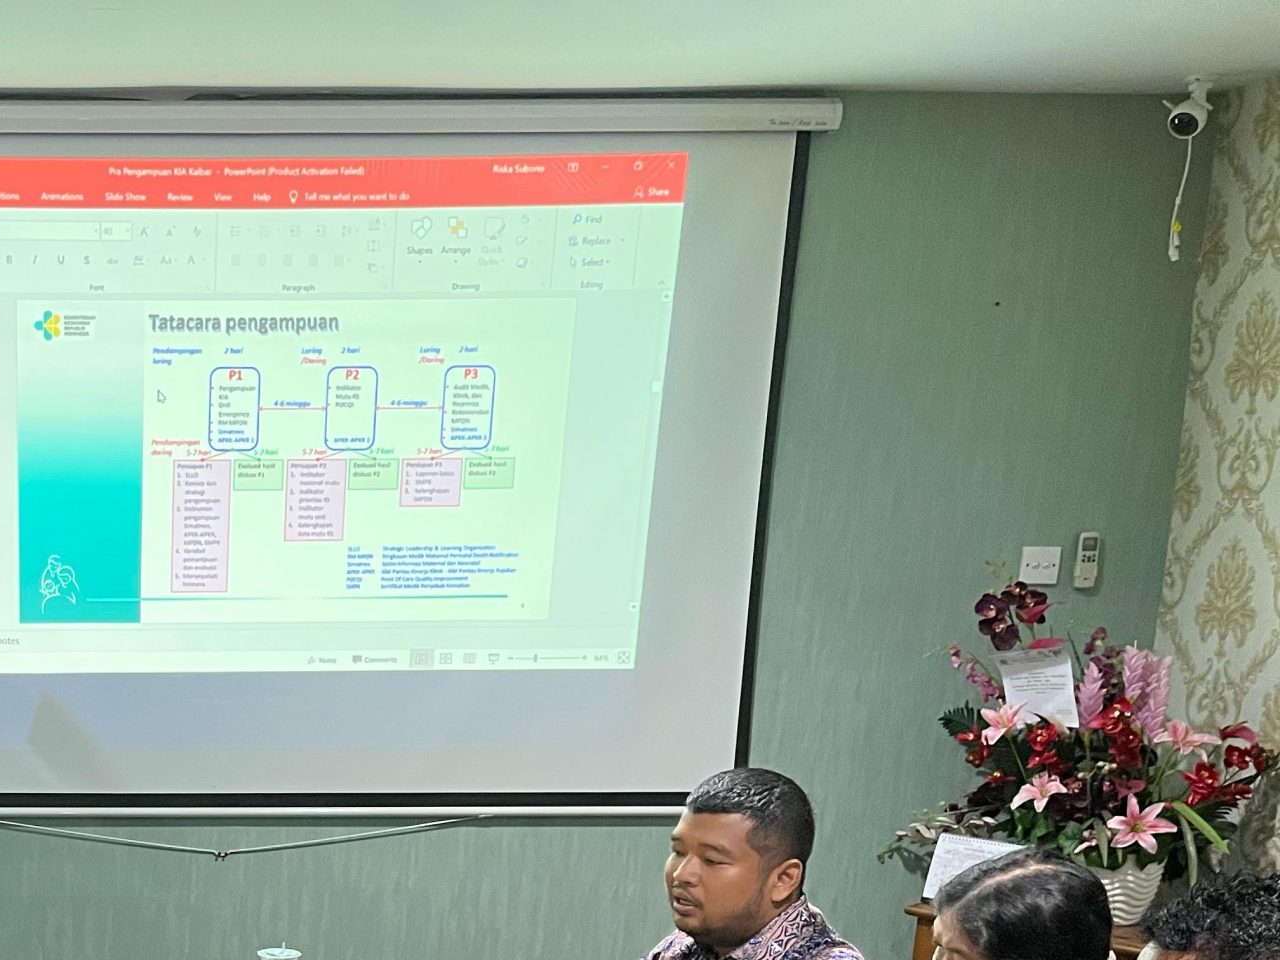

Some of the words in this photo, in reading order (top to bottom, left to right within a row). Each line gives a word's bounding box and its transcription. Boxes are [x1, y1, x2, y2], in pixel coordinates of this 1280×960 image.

[109, 167, 121, 176] Pra
[123, 167, 172, 178] Pengampuan
[173, 167, 187, 176] KIA
[224, 167, 266, 176] PowerPoint
[268, 167, 300, 177] (Product
[301, 167, 338, 176] Activation
[340, 166, 365, 177] Failed)
[493, 164, 513, 173] Riska
[41, 192, 84, 201] Animations
[104, 192, 123, 201] Slide
[125, 192, 146, 201] Show
[167, 192, 193, 201] Review
[214, 192, 232, 201] View
[648, 188, 669, 196] Share
[253, 192, 271, 203] Help
[304, 192, 318, 201] Tell
[332, 192, 351, 201] what
[352, 194, 366, 203] you
[368, 193, 386, 201] want
[398, 192, 410, 201] do
[585, 215, 602, 224] Find
[582, 236, 611, 247] Replace
[407, 246, 433, 256] Shapes
[441, 246, 471, 255] Arrange
[581, 258, 603, 267] Select
[89, 283, 105, 292] Font
[282, 283, 315, 293] Paragraph
[452, 282, 480, 292] Drawing
[581, 280, 603, 290] Editing
[149, 314, 223, 332] Tatacara
[226, 315, 340, 336] pengampuan
[152, 347, 203, 356] Pendampingan
[301, 347, 323, 356] Luring
[347, 346, 361, 354] hari
[420, 346, 441, 354] Luring
[465, 345, 478, 353] hari
[228, 369, 243, 381] P1
[345, 369, 360, 381] P2
[464, 368, 478, 380] P3
[319, 656, 337, 664] Notes
[364, 656, 398, 664] Comments
